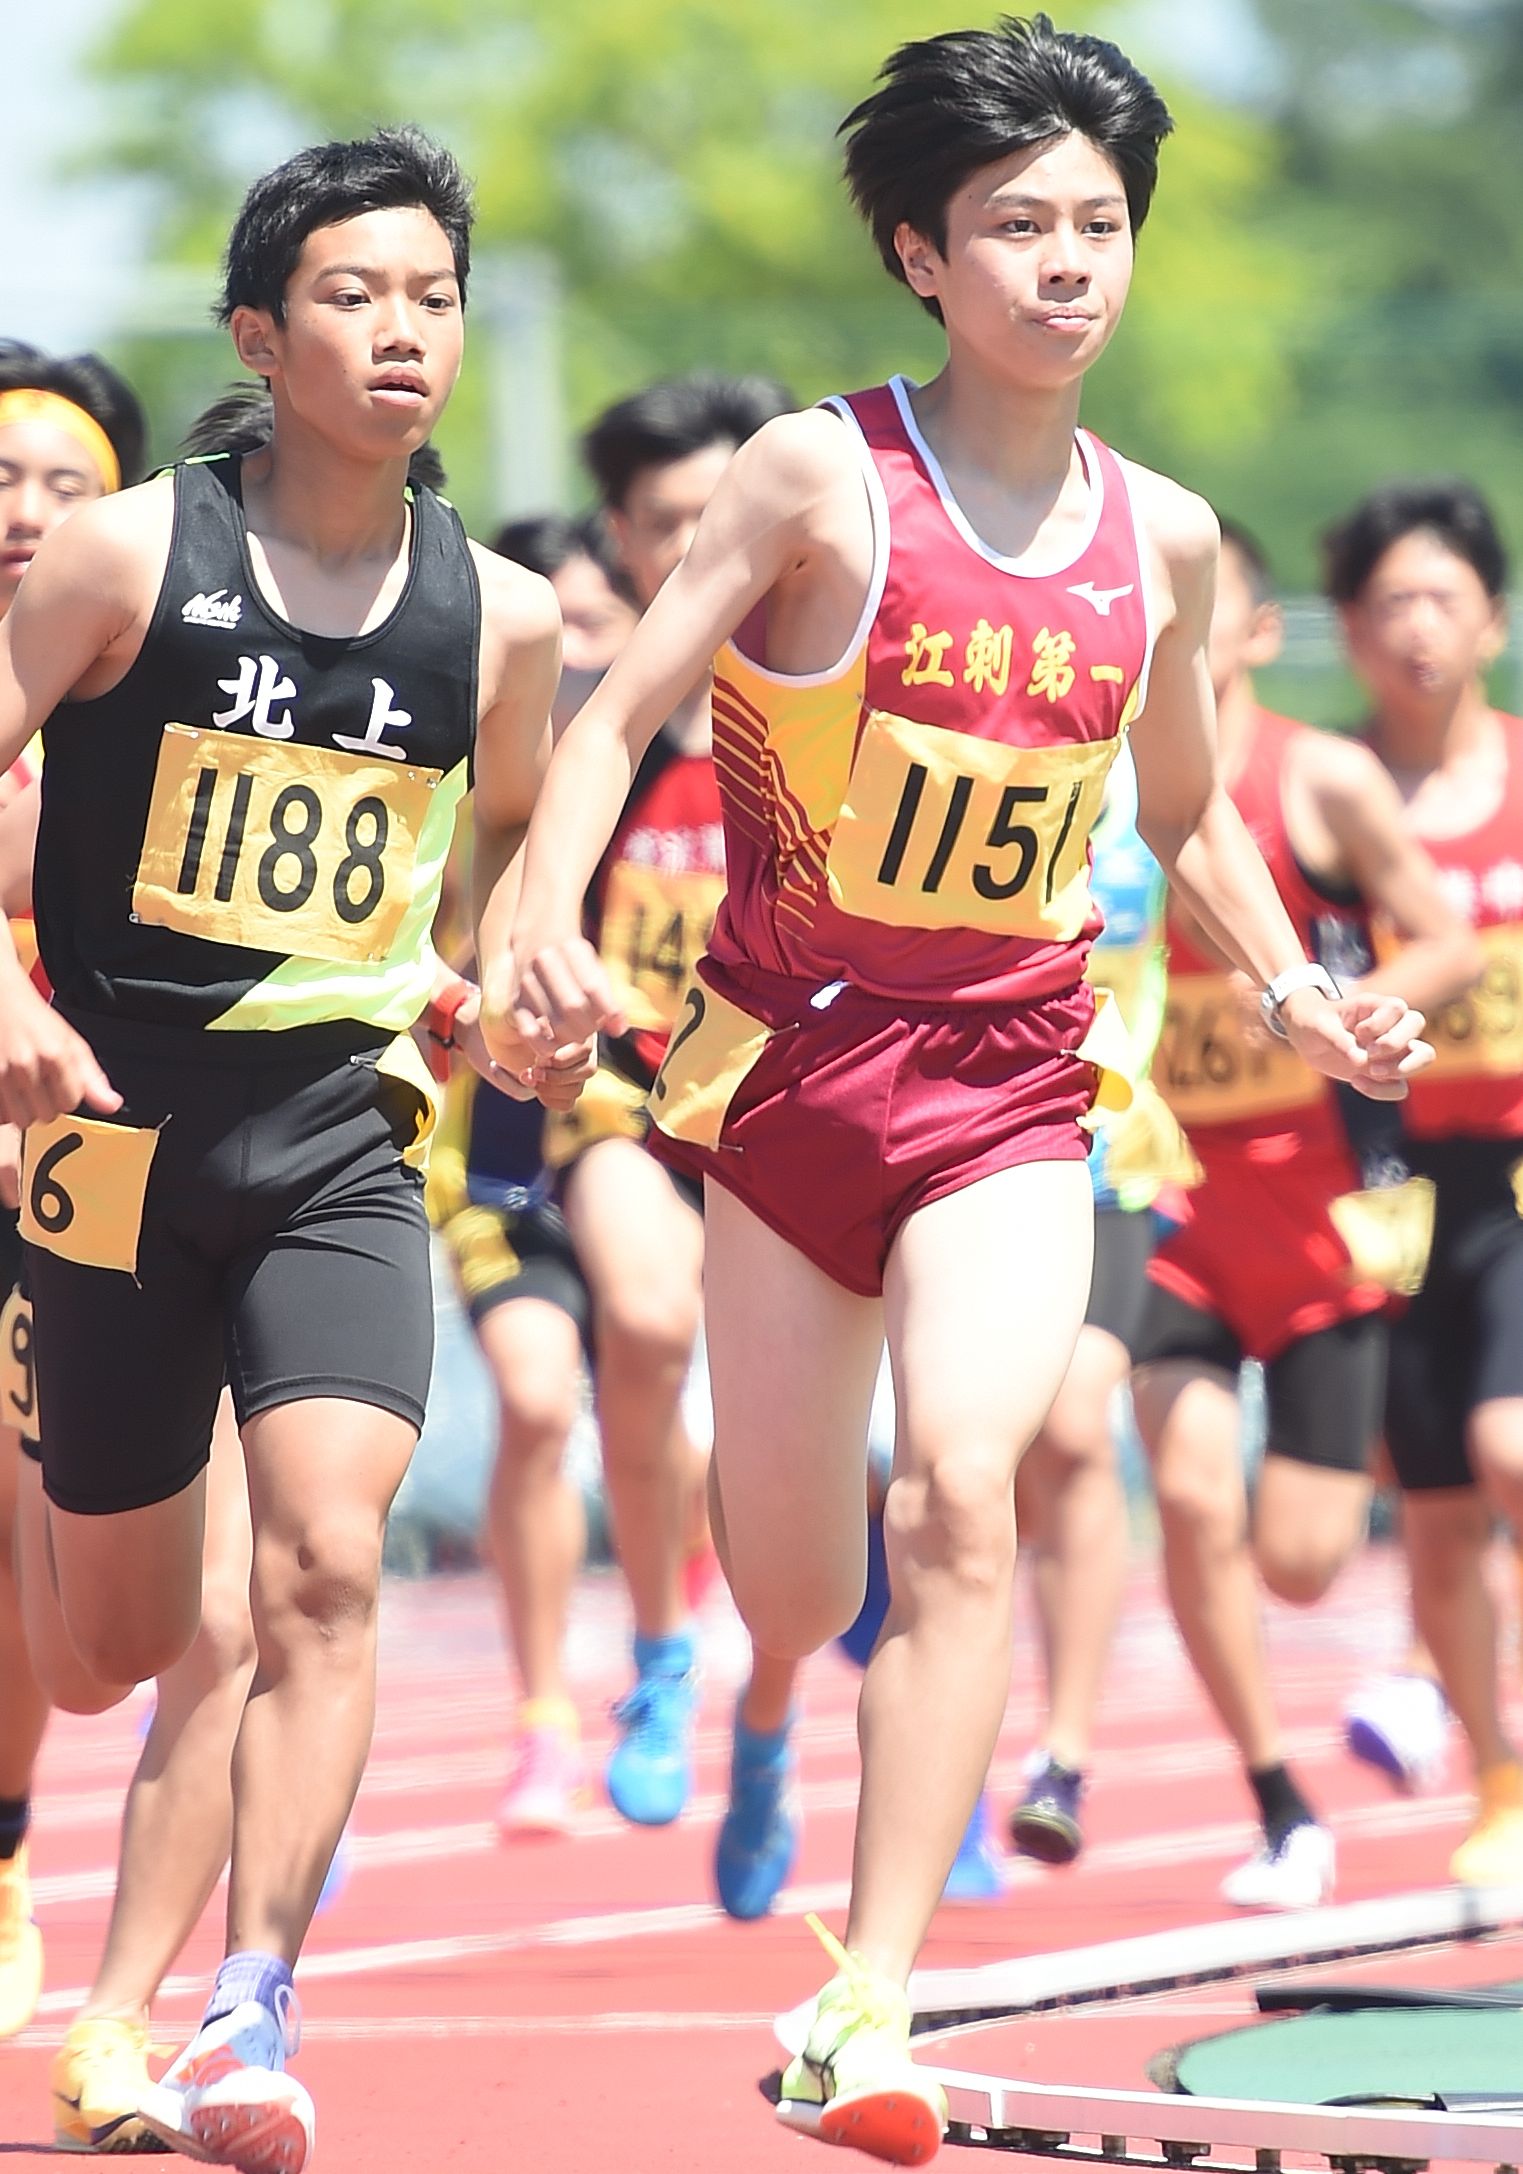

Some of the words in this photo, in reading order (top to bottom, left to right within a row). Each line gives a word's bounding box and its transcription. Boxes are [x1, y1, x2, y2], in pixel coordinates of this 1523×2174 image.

[213, 655, 412, 760] 北上
[902, 619, 1125, 703] 江刺第一
[177, 767, 389, 924] 1188
[877, 763, 1083, 904] 1151
[31, 1132, 84, 1234] 6
[10, 1313, 34, 1417] 9
